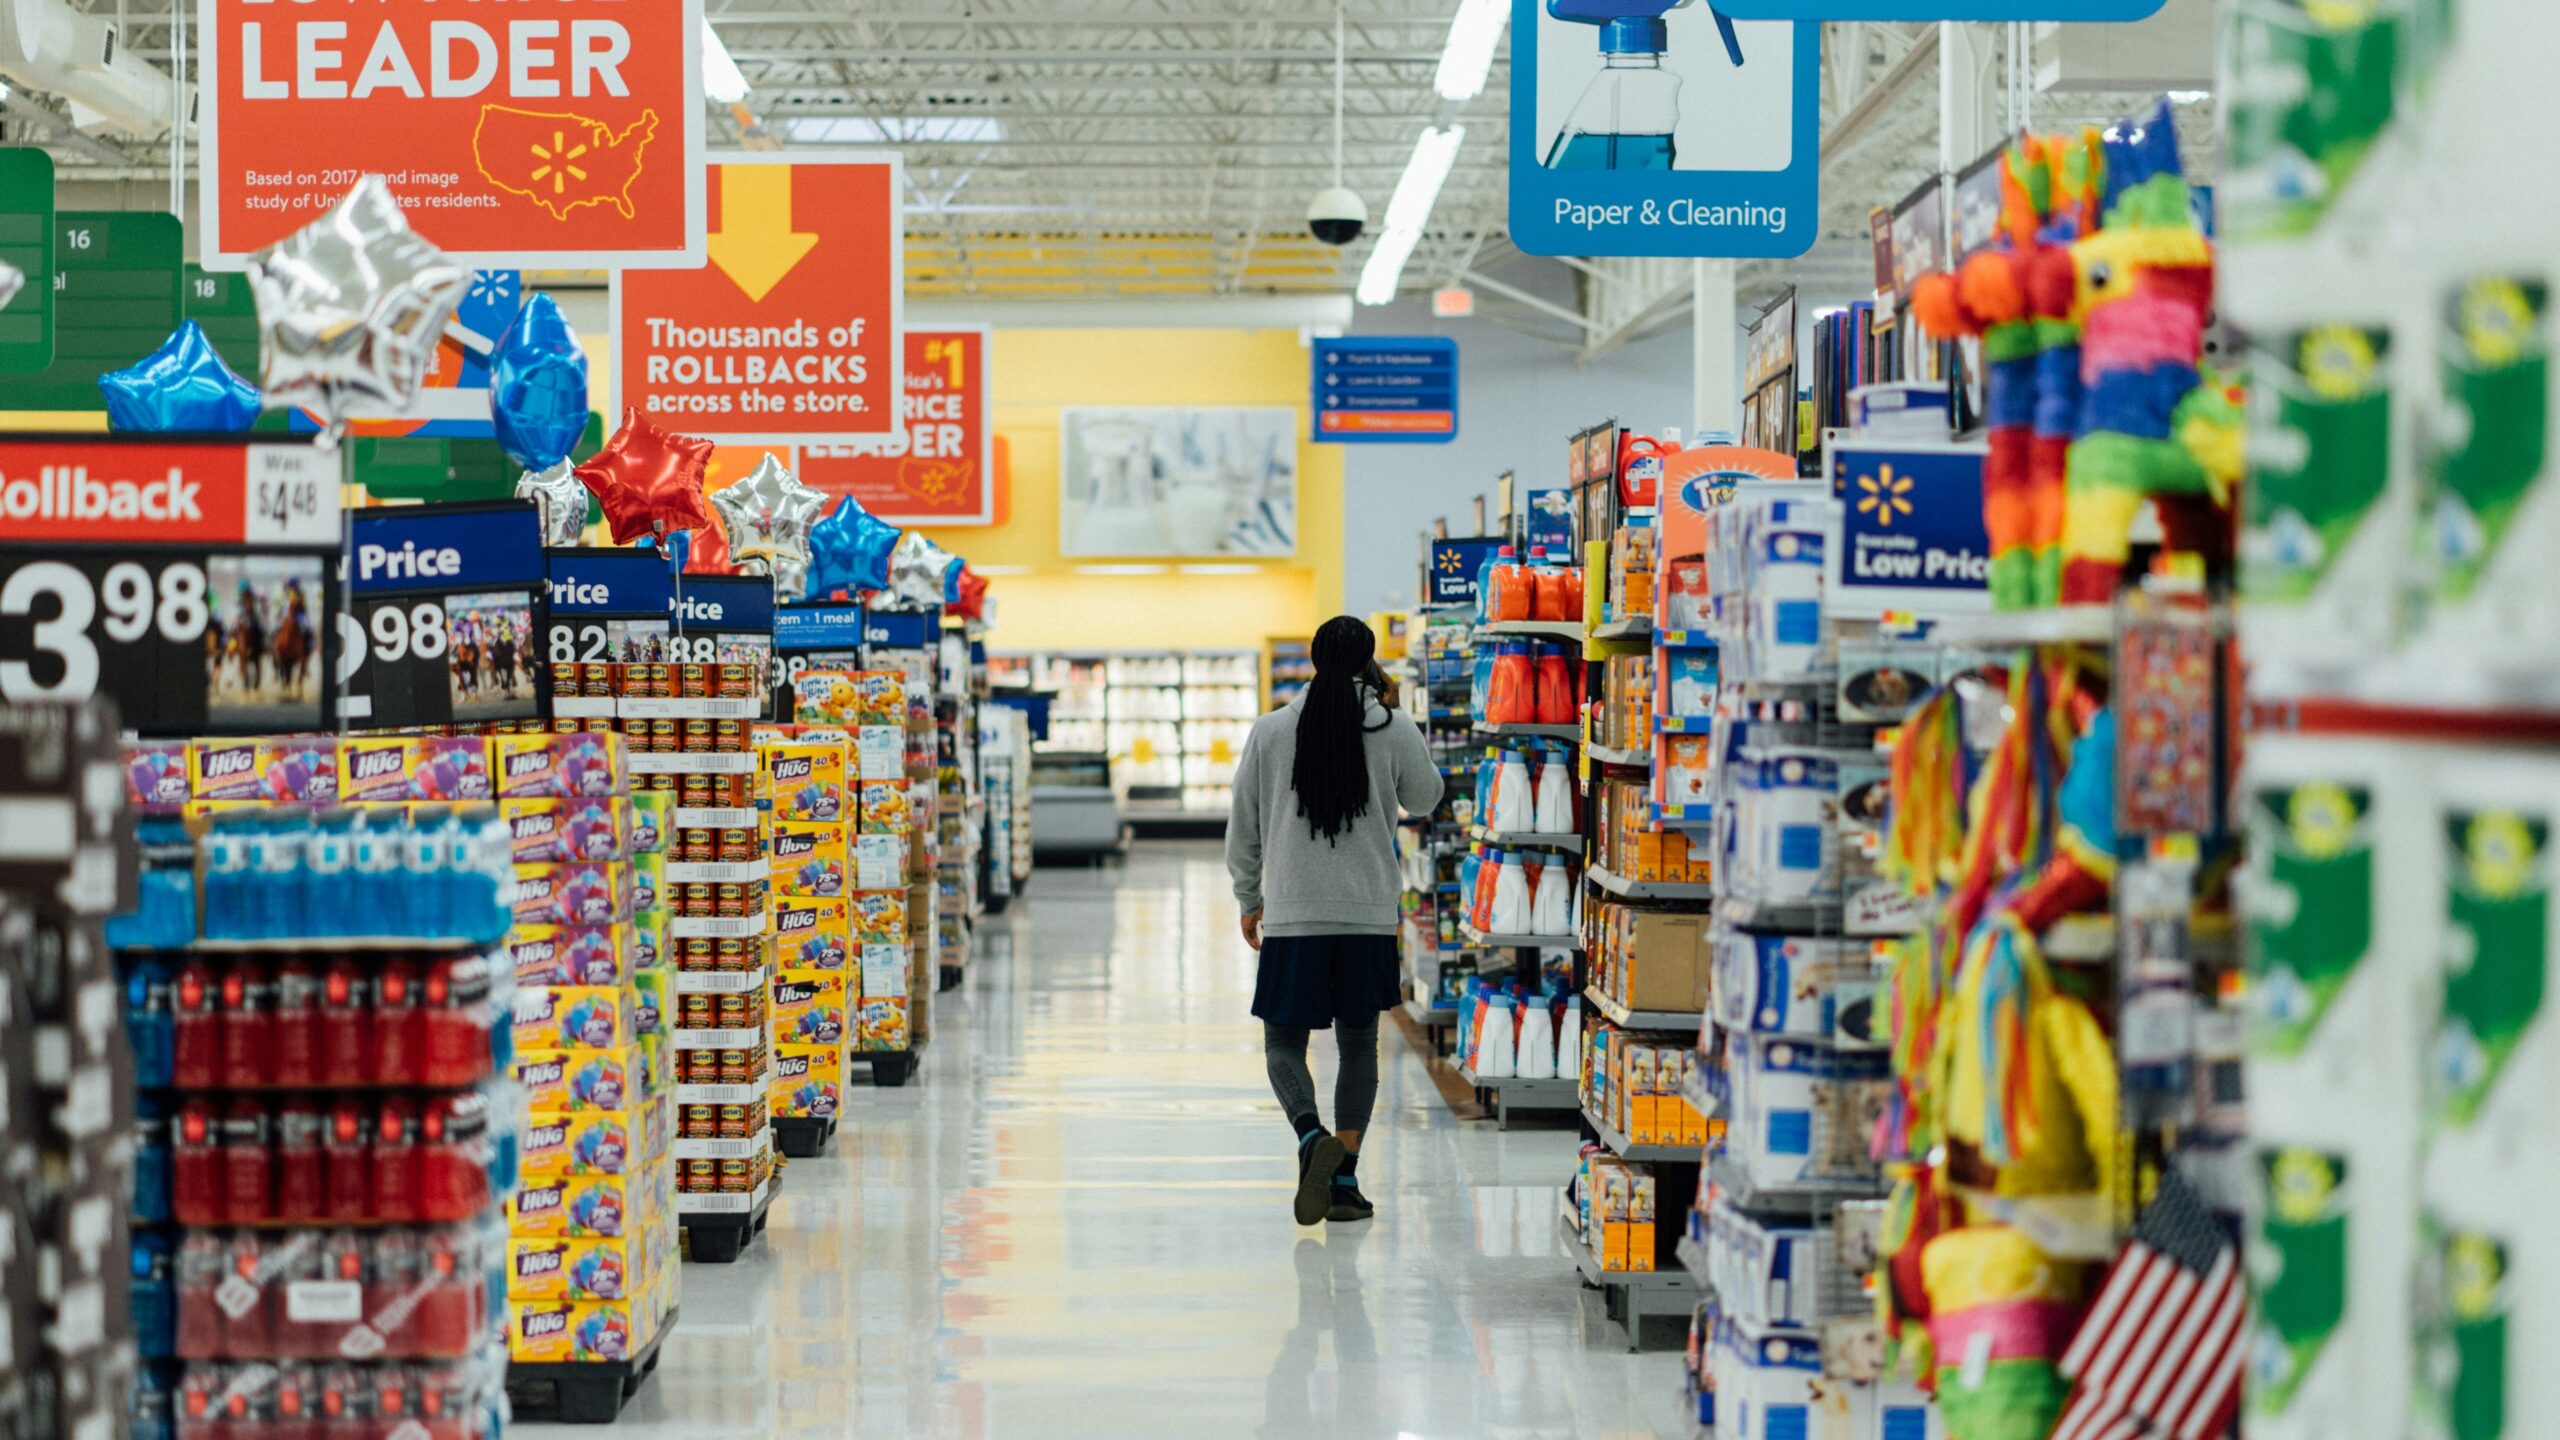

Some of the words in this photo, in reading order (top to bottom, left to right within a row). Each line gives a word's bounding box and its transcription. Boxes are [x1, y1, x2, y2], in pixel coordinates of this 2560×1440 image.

[243, 19, 631, 99] LEADER
[245, 170, 294, 187] Based
[296, 174, 317, 187] on
[321, 170, 357, 186] 2017
[411, 170, 459, 188] image
[245, 194, 289, 213] study
[292, 193, 311, 209] of
[425, 192, 501, 208] residents.
[1554, 198, 1634, 231] Paper
[1640, 199, 1661, 226] &
[1667, 199, 1787, 233] Cleaning
[66, 229, 92, 250] 16
[194, 279, 216, 299] 18
[645, 317, 820, 349] Thousands
[827, 317, 866, 349] of
[646, 354, 868, 385] ROLLBACKS
[924, 338, 965, 390] #1
[645, 390, 733, 413] across
[740, 388, 787, 413] the
[793, 390, 870, 413] store.
[903, 394, 964, 420] RICE
[358, 540, 462, 581] Price
[1853, 548, 1922, 578] Low
[1439, 580, 1467, 595] Low
[814, 611, 821, 624] 1
[823, 611, 855, 625] meal
[548, 624, 608, 663] 82
[669, 636, 716, 663] 88
[723, 668, 744, 676] BUSH'S
[589, 722, 609, 730] BUSH'S
[776, 761, 810, 779] HUG
[814, 756, 828, 766] 40
[688, 832, 709, 840] BUSH'S
[817, 832, 831, 842] 40
[782, 912, 816, 931] HUG
[820, 908, 834, 917] 40
[812, 1055, 825, 1064] 40
[690, 1109, 711, 1117] BUSH'S
[722, 1108, 743, 1116] BUSH'S
[692, 1163, 713, 1171] BUSH'S
[724, 1163, 744, 1171] BUSH'S
